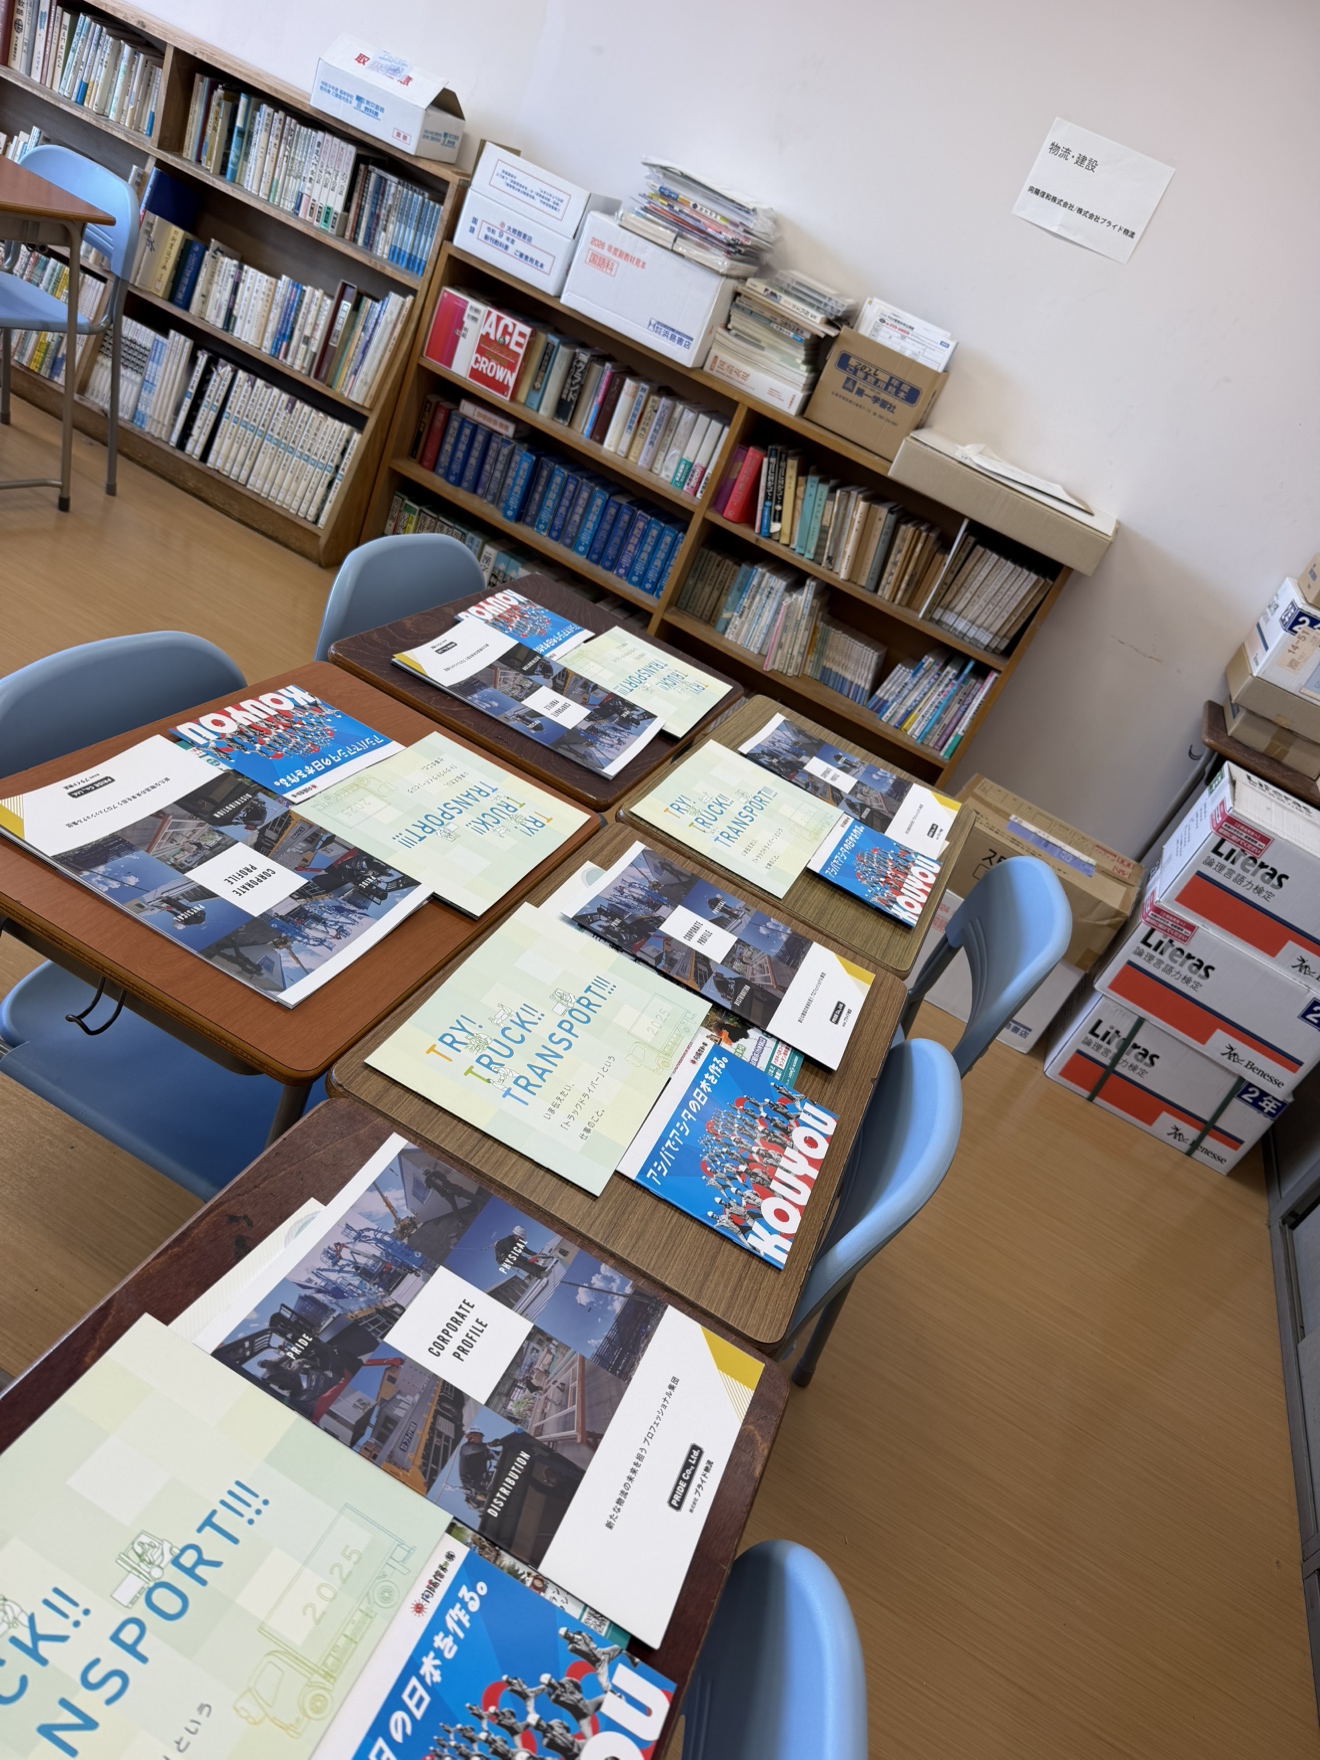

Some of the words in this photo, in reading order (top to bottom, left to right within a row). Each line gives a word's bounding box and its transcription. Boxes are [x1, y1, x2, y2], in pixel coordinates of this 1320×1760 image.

[1046, 140, 1099, 173] 物流・建設
[480, 310, 531, 354] ACE
[661, 329, 691, 349] 浜島書店
[470, 353, 516, 387] CROWN
[854, 386, 897, 414] 第一学習社
[613, 659, 667, 696] TRANSPORT!!!
[655, 670, 687, 691] TRUCK!!
[175, 683, 315, 746] KOUYOU
[272, 730, 384, 791] アシバでアシタの日本を作る。
[212, 792, 252, 818] DISTRIBUTION
[340, 795, 371, 819] 2025
[391, 780, 498, 849] TRANSPORT!!!
[464, 796, 525, 835] TRUCK!!
[513, 810, 553, 838] TRY!
[663, 793, 695, 819] TRY!
[688, 792, 734, 831] TRUCK!!
[713, 785, 777, 847] TRANSPORT!!!
[824, 823, 865, 878] アシバでアシタの日本を作る。
[1209, 835, 1290, 891] Literas
[223, 862, 257, 886] PROFILE
[231, 866, 276, 897] CORPORATE
[357, 874, 376, 889] PRIDE
[890, 856, 941, 925] KOUYOU
[1201, 855, 1276, 902] 論理言語力検定
[172, 902, 205, 923] PHYSICAL
[683, 919, 702, 941] CORPORATE
[697, 929, 712, 945] PROFILE
[1139, 926, 1216, 982] Literas
[1133, 944, 1202, 992] 論理言語力検定
[425, 1013, 483, 1061] TRY!
[502, 975, 616, 1105] TRANSPORT!!!
[647, 1007, 670, 1036] 2025
[463, 1002, 545, 1082] TRUCK!!
[560, 1054, 616, 1131] 「トラックドライバー」という
[1245, 1058, 1285, 1089] Benesse
[543, 1081, 575, 1120] いま伝えたい。
[647, 1055, 729, 1185] アシバでアシタの日本を作る。
[1240, 1084, 1282, 1117] 2年
[579, 1108, 605, 1141] 仕事のこと。
[746, 1103, 839, 1262] KOUYOU
[498, 1237, 528, 1274] PHYSICAL
[286, 1332, 313, 1360] PRIDE
[427, 1298, 475, 1357] CORPORATE
[452, 1317, 488, 1361] PROFILE
[604, 1446, 648, 1529] 新たな物流の未来を担う
[642, 1375, 680, 1445] プロフェッショナル集団
[487, 1449, 531, 1517] DISTRIBUTION
[670, 1479, 687, 1507] PRIDE
[688, 1447, 700, 1464] Ltd.
[694, 1458, 714, 1496] プライド物流
[299, 1544, 364, 1624] 2025
[35, 1480, 270, 1755] NSPORT!!!
